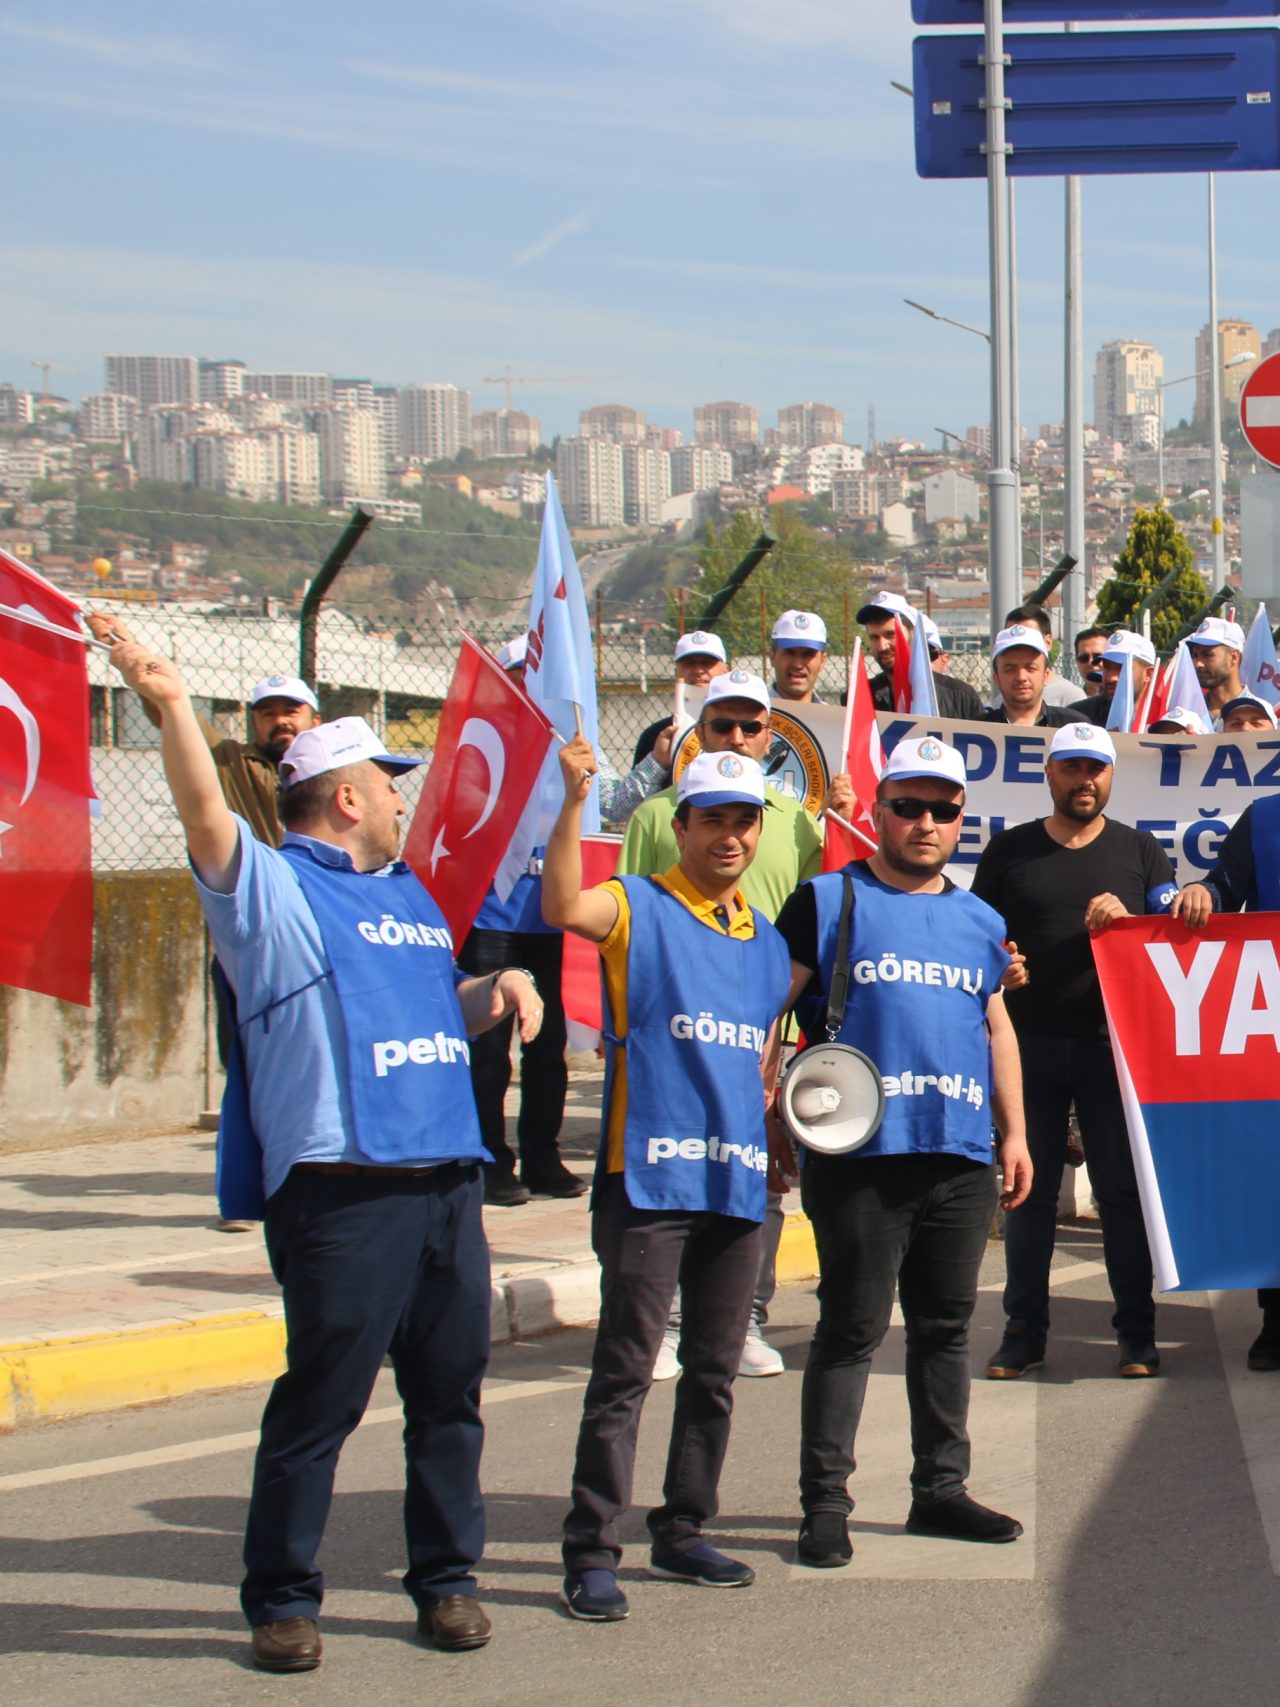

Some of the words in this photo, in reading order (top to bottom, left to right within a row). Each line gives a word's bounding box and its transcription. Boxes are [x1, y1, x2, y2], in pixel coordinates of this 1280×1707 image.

[806, 761, 820, 812] SENDİKAS
[357, 914, 454, 950] GÖREV
[853, 952, 983, 995] GÖREVLİ
[670, 1011, 766, 1054] GÖREV
[881, 1070, 984, 1111] etrol-iş
